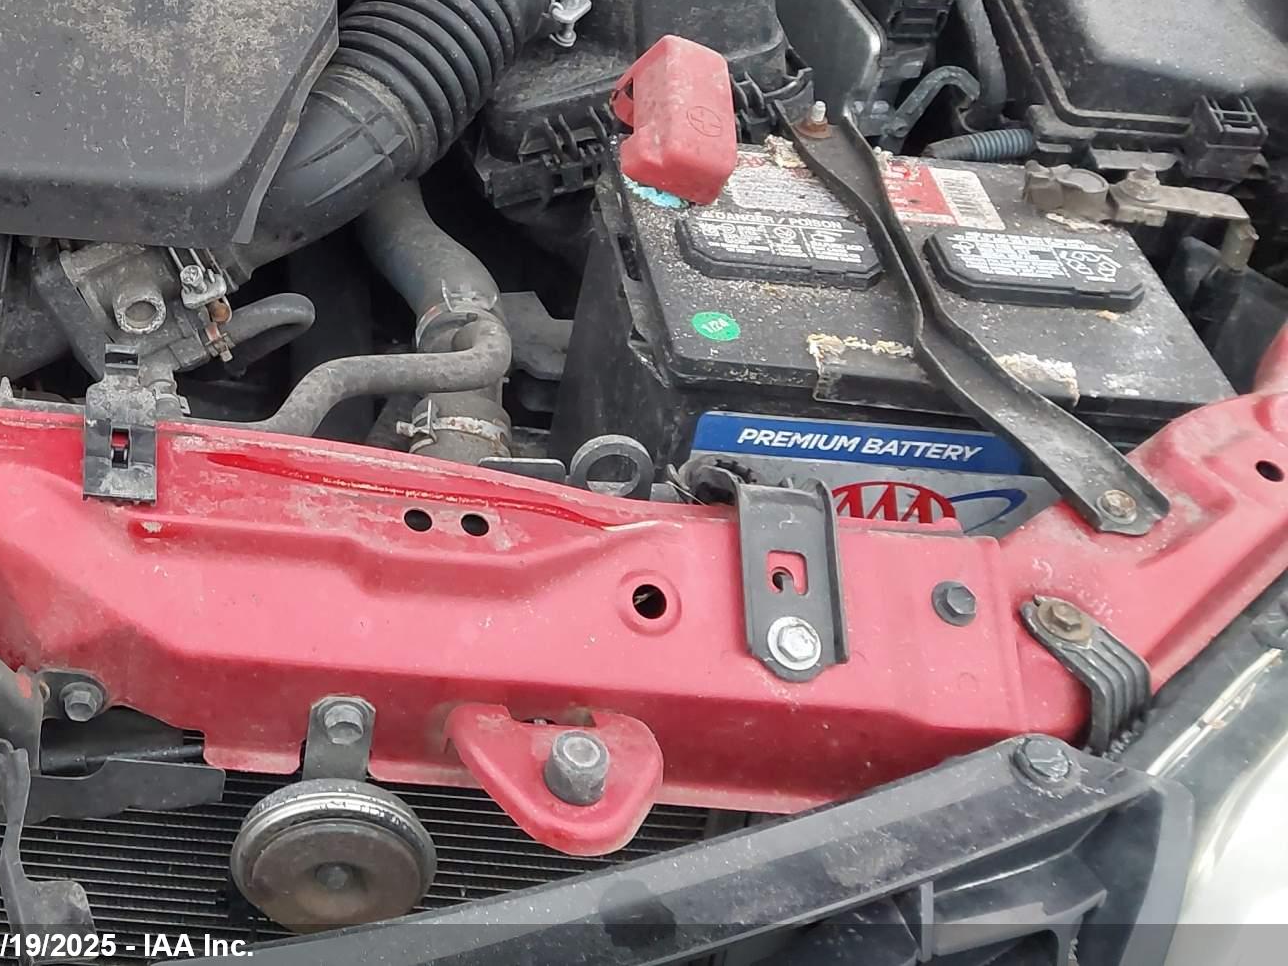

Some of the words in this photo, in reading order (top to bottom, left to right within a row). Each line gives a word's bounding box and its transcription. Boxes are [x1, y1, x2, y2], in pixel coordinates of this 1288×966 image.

[714, 210, 775, 225] DANGER
[777, 216, 785, 225] /
[788, 216, 843, 230] POISON
[737, 428, 858, 452] PREMIUM
[861, 438, 983, 462] BATTERY
